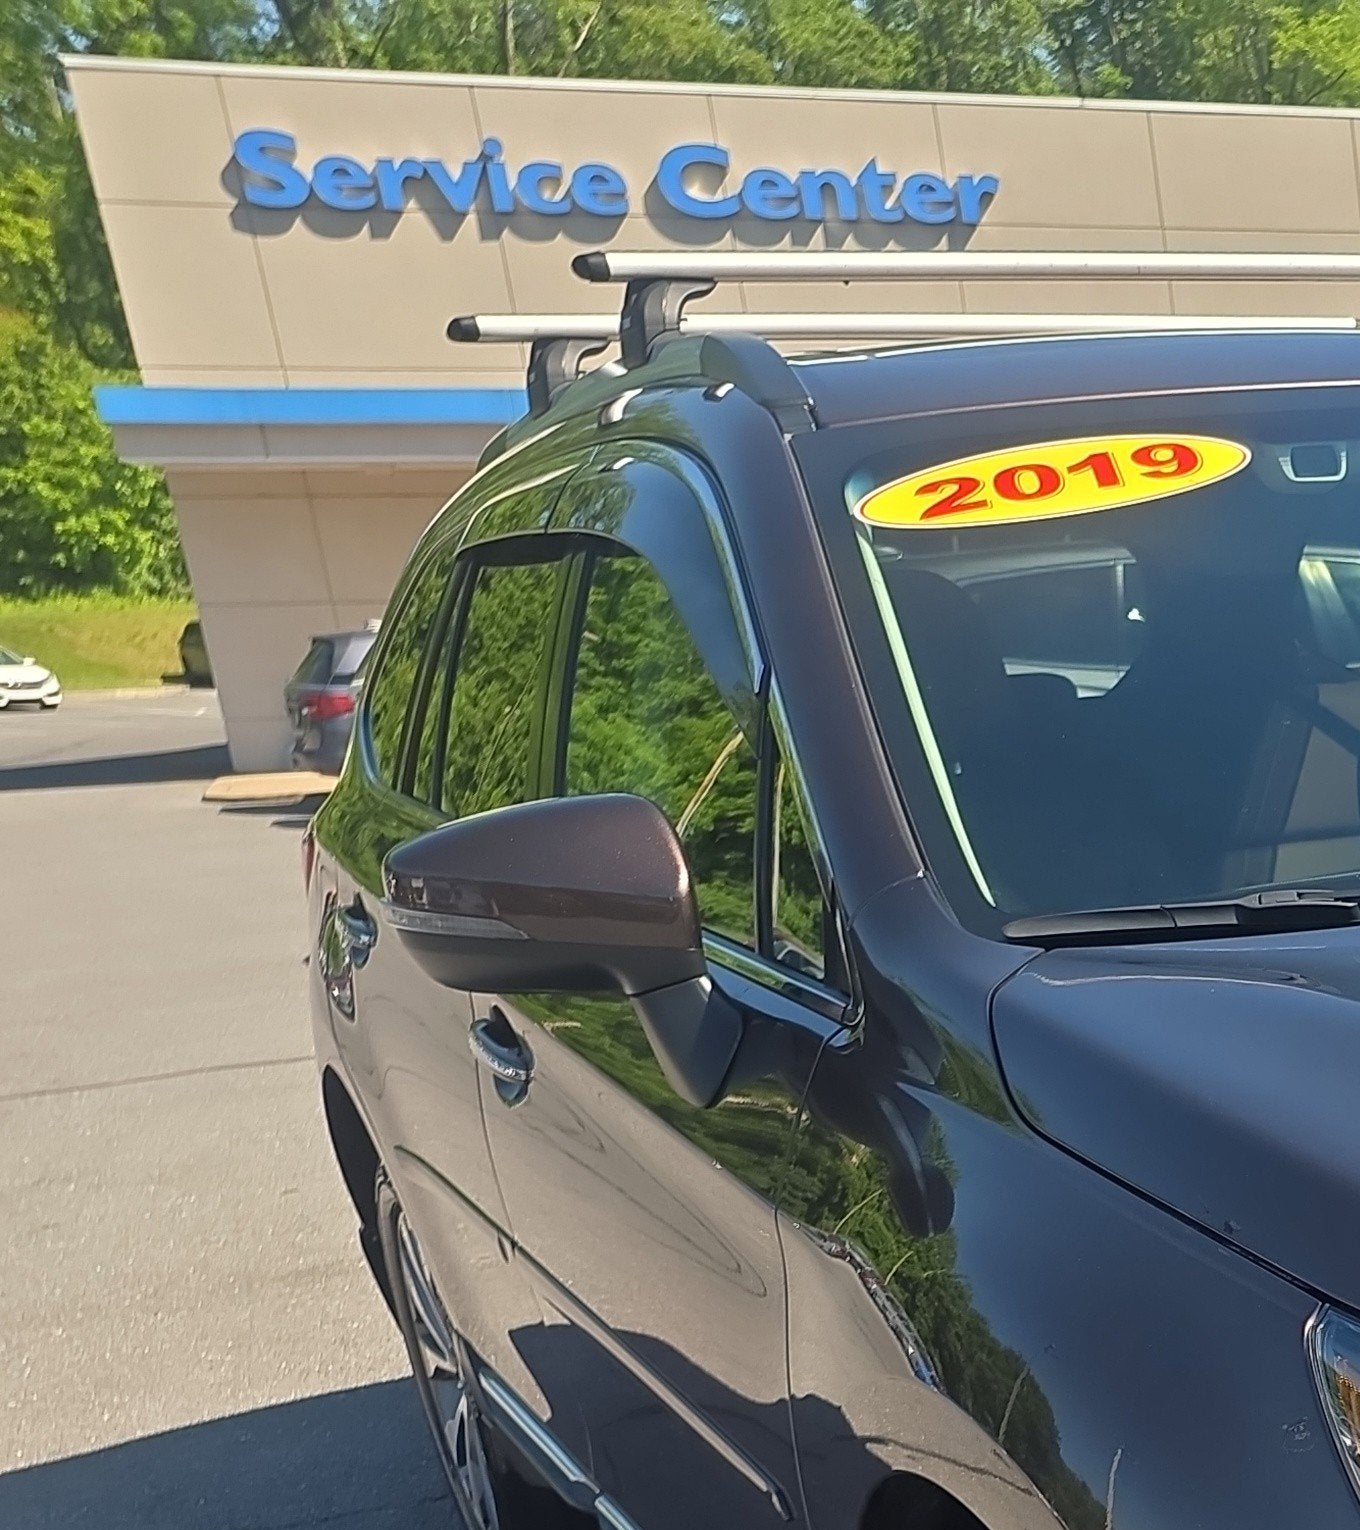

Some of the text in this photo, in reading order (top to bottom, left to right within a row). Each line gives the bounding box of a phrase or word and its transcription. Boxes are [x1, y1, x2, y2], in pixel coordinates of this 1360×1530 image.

[233, 128, 998, 224] Service Center
[914, 443, 1201, 521] 2019
